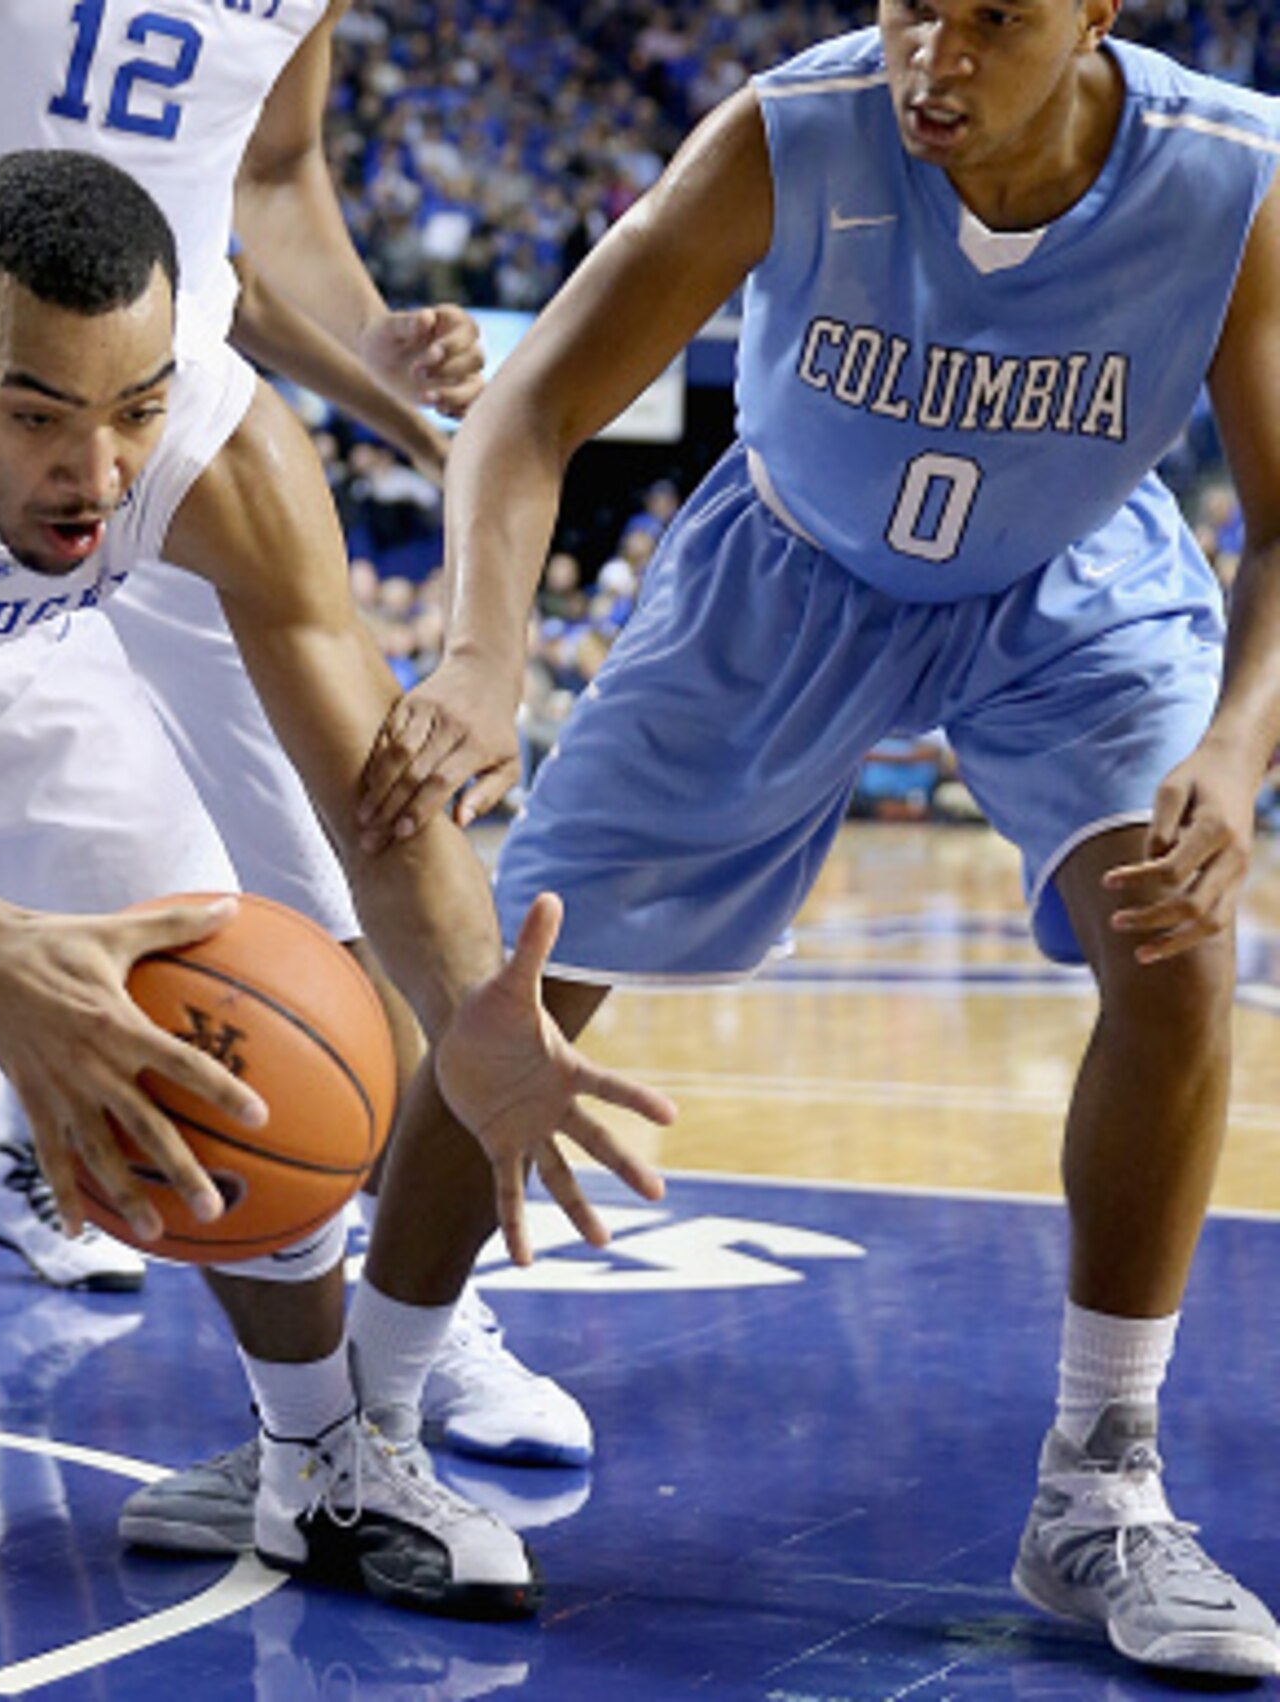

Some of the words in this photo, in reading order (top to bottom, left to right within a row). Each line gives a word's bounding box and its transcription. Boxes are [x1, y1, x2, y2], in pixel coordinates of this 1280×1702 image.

[47, 0, 204, 141] 12
[797, 315, 1130, 441] COLUMBIA
[884, 449, 984, 564] 0
